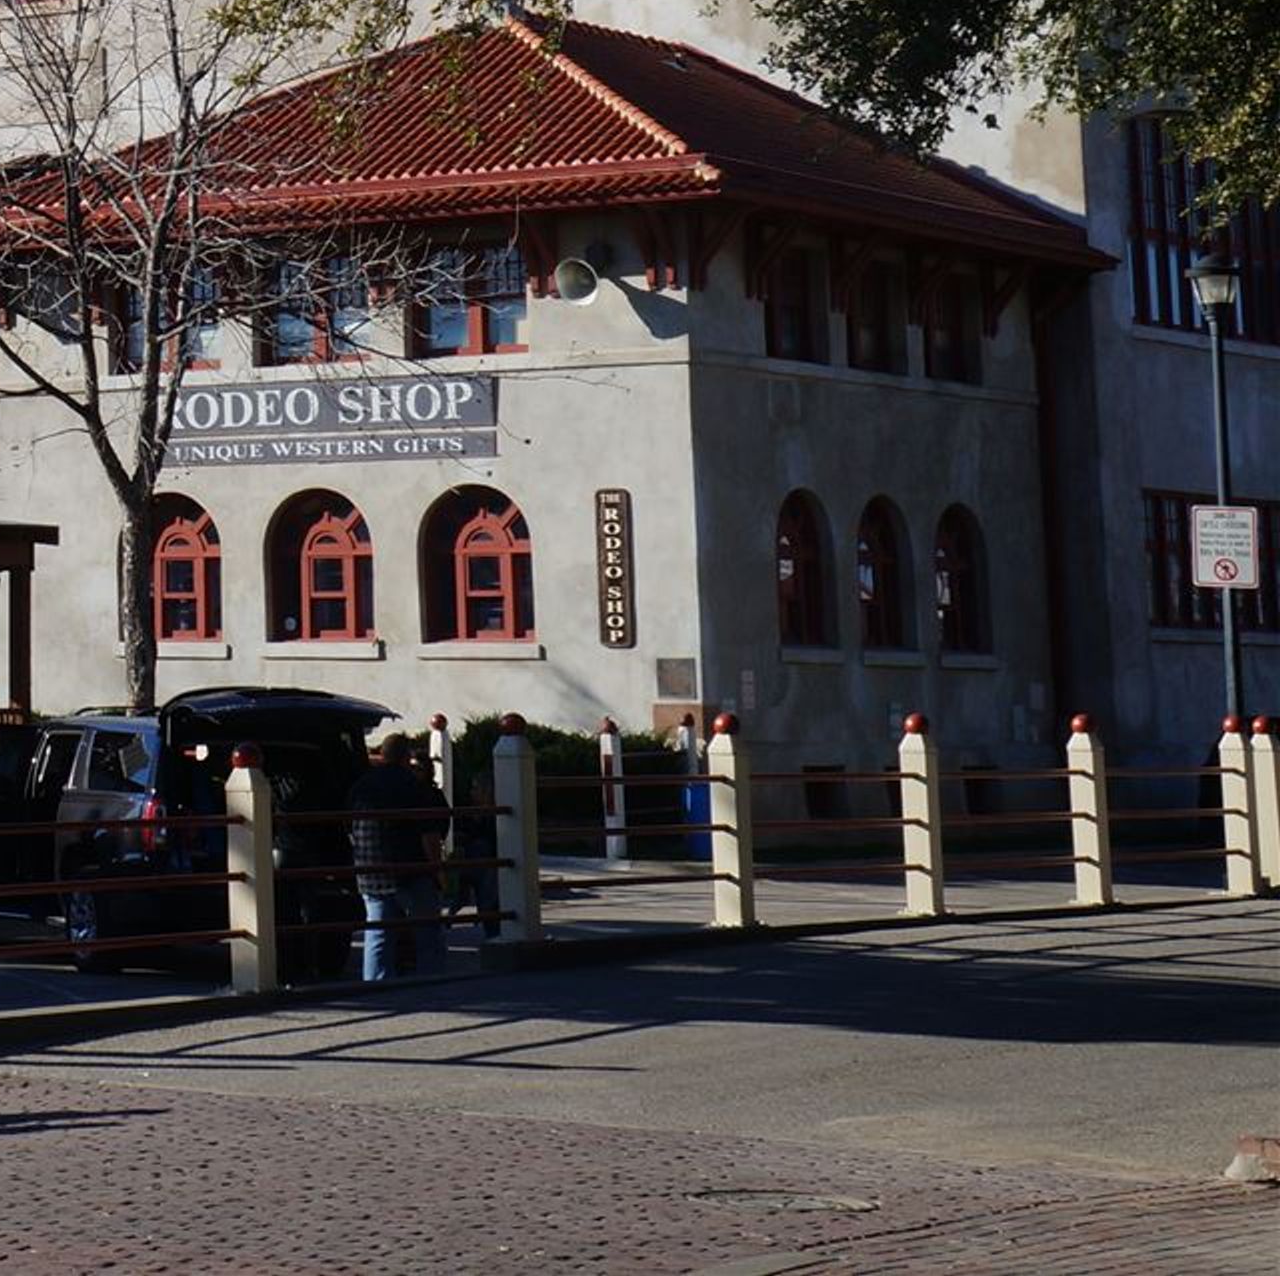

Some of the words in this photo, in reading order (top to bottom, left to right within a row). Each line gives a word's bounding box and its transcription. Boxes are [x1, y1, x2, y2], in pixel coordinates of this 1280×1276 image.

[337, 381, 474, 424] SHOP
[174, 441, 264, 462] UNIQUE
[271, 439, 385, 458] WESTERN
[393, 436, 464, 454] GIFTS
[603, 507, 623, 580] RODEO
[605, 586, 625, 642] SHOP
